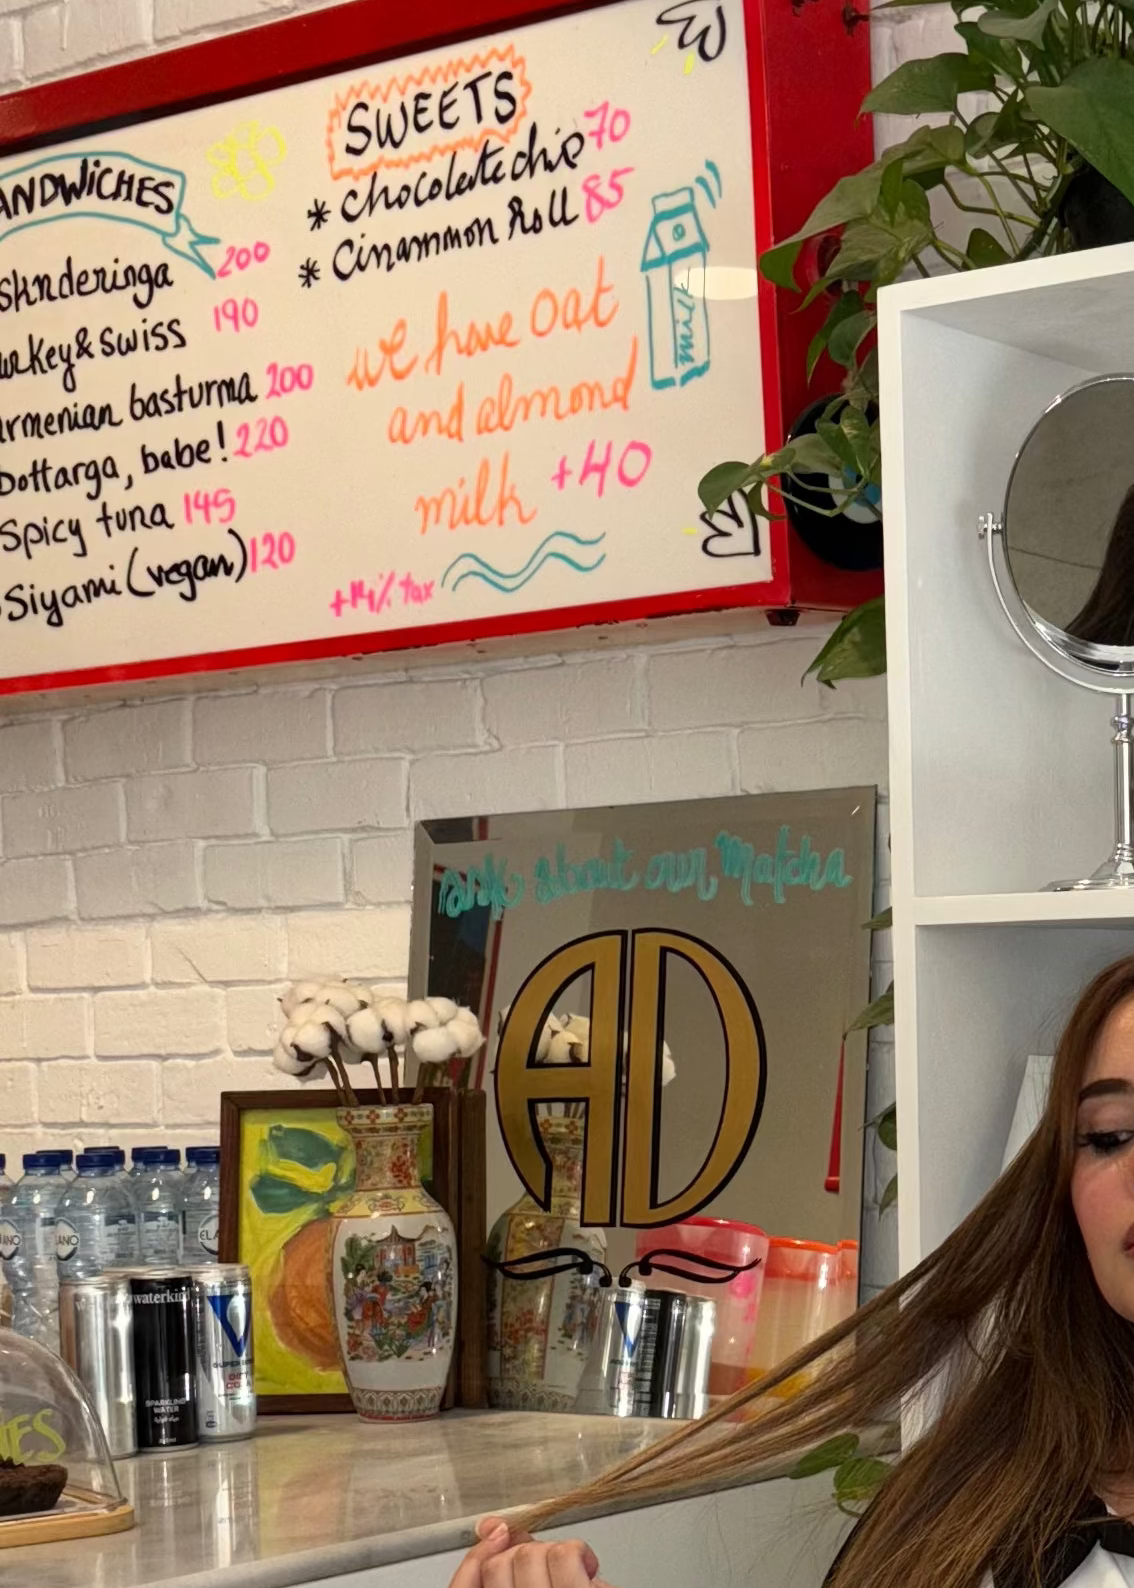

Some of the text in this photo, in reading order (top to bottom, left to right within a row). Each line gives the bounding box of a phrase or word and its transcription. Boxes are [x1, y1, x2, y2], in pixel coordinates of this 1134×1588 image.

[345, 69, 518, 157] SWEETS
[584, 101, 631, 151] 70
[508, 186, 580, 241] Roll
[582, 167, 635, 223] 85
[215, 241, 270, 279] 200
[213, 297, 259, 333] 190
[425, 290, 521, 375] have
[130, 373, 258, 421] basturma
[265, 362, 314, 399] 200
[387, 335, 638, 444] and almond
[140, 420, 230, 475] babe!
[233, 415, 289, 458] 220
[96, 501, 175, 539] tuna
[184, 488, 236, 525] 145
[414, 440, 652, 535] milk +40
[4, 528, 296, 627] Siyami (vegan) 120
[132, 1288, 191, 1306] waterkind
